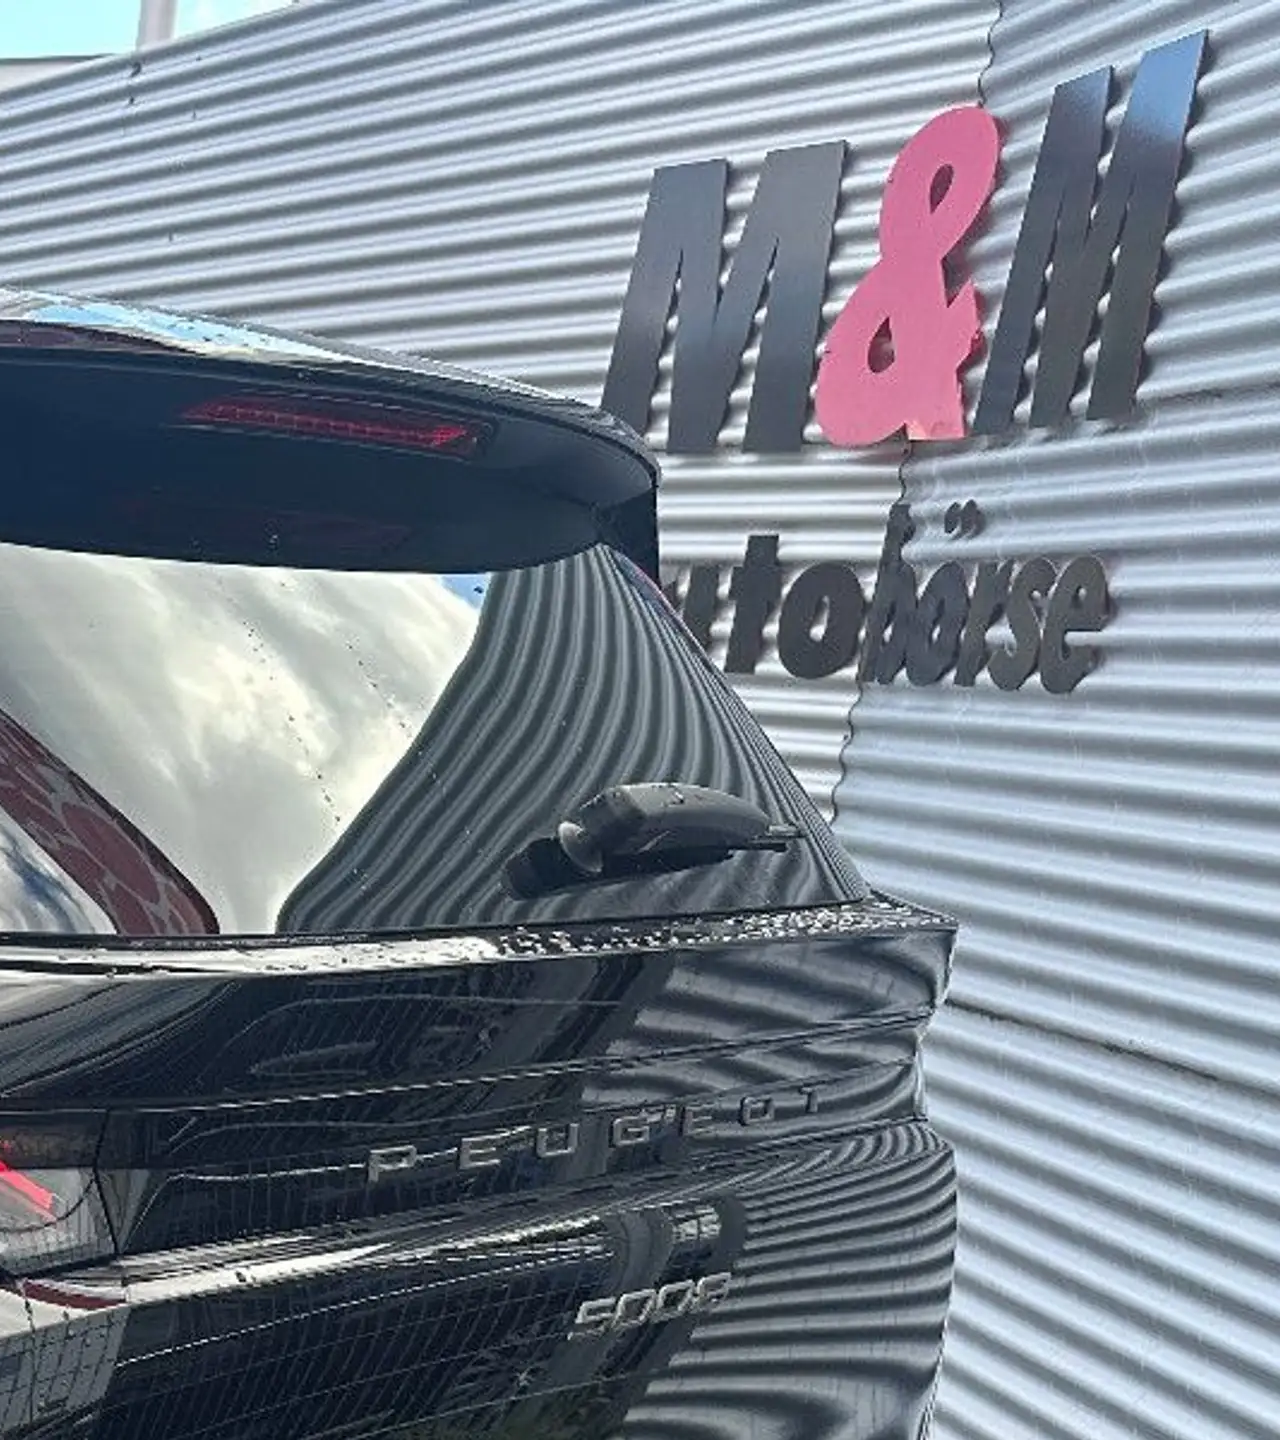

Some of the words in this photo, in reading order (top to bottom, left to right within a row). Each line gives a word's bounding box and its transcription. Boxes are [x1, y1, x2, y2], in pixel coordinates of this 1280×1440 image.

[600, 30, 1209, 455] M&M
[664, 498, 1109, 695] utobörse
[368, 1086, 820, 1184] PEUGEOT
[567, 1271, 732, 1341] 5008
